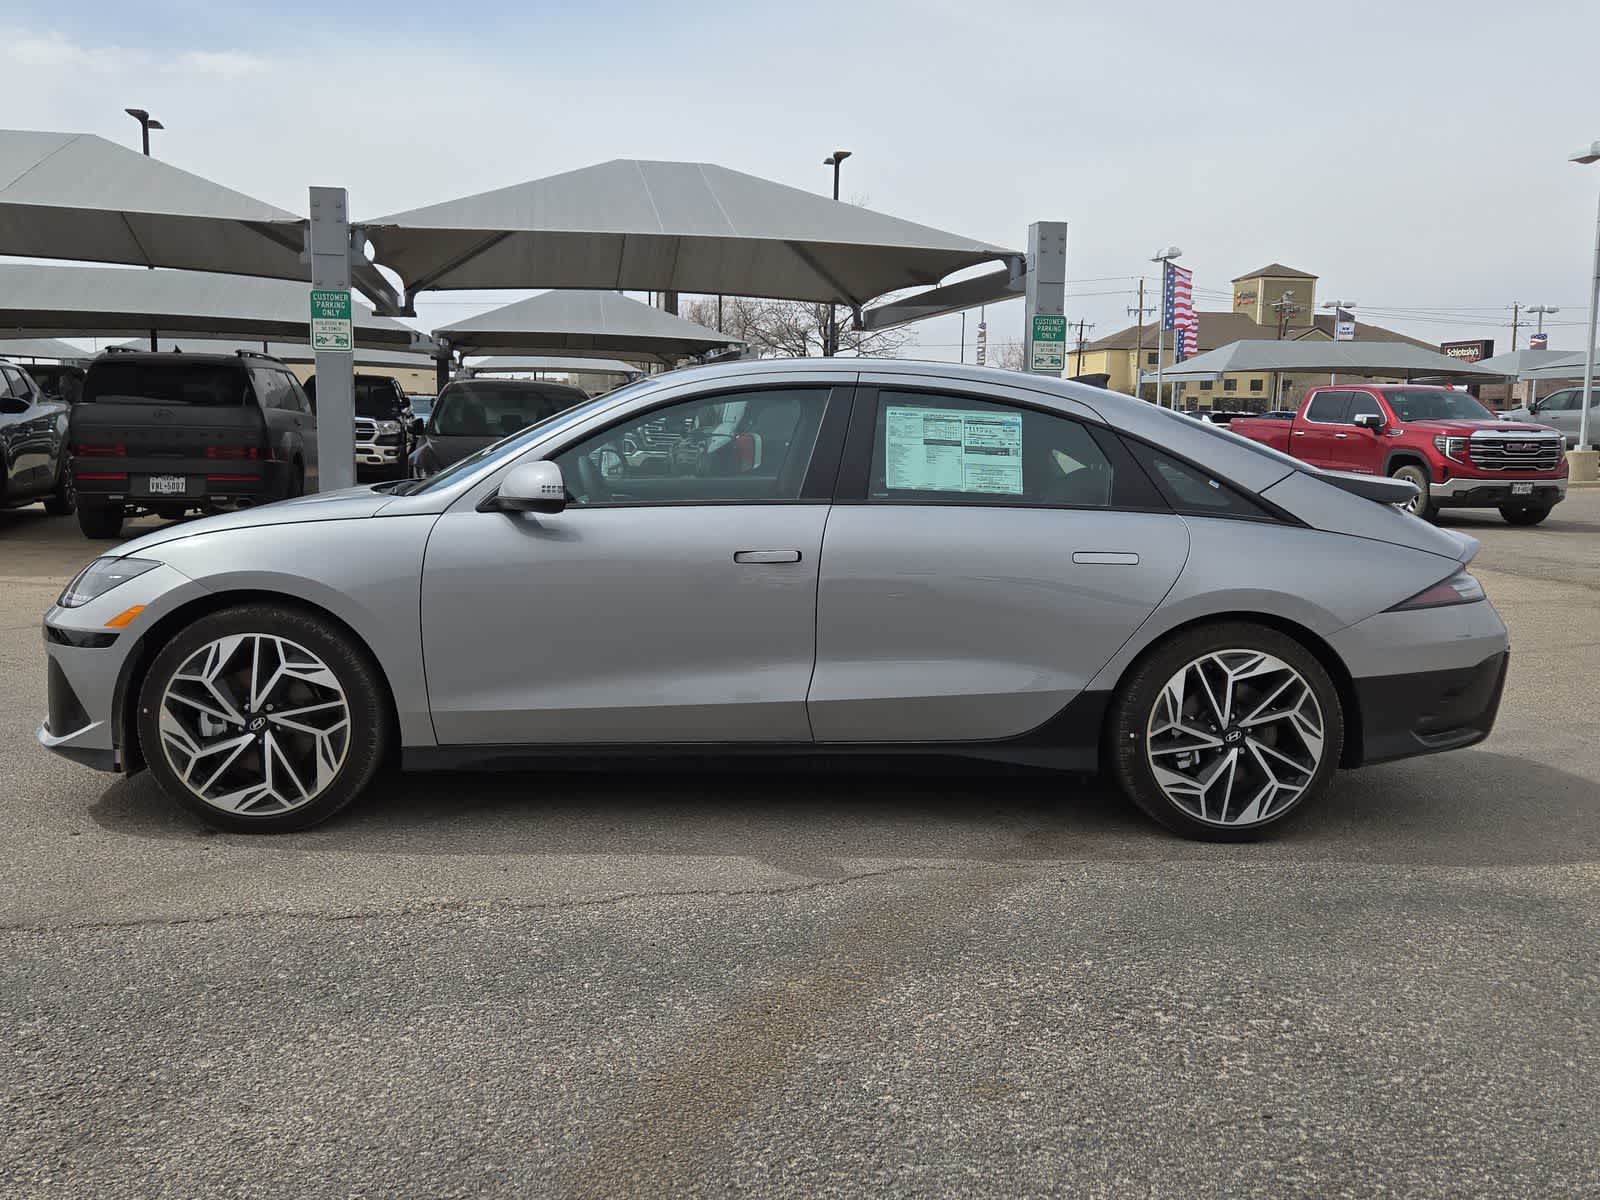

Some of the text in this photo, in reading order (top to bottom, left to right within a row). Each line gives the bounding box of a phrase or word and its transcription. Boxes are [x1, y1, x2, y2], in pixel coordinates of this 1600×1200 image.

[312, 293, 349, 301] CUSTOMER
[316, 301, 346, 309] PARKING
[322, 309, 340, 317] ONLY
[1446, 347, 1479, 357] Schlotzsky's
